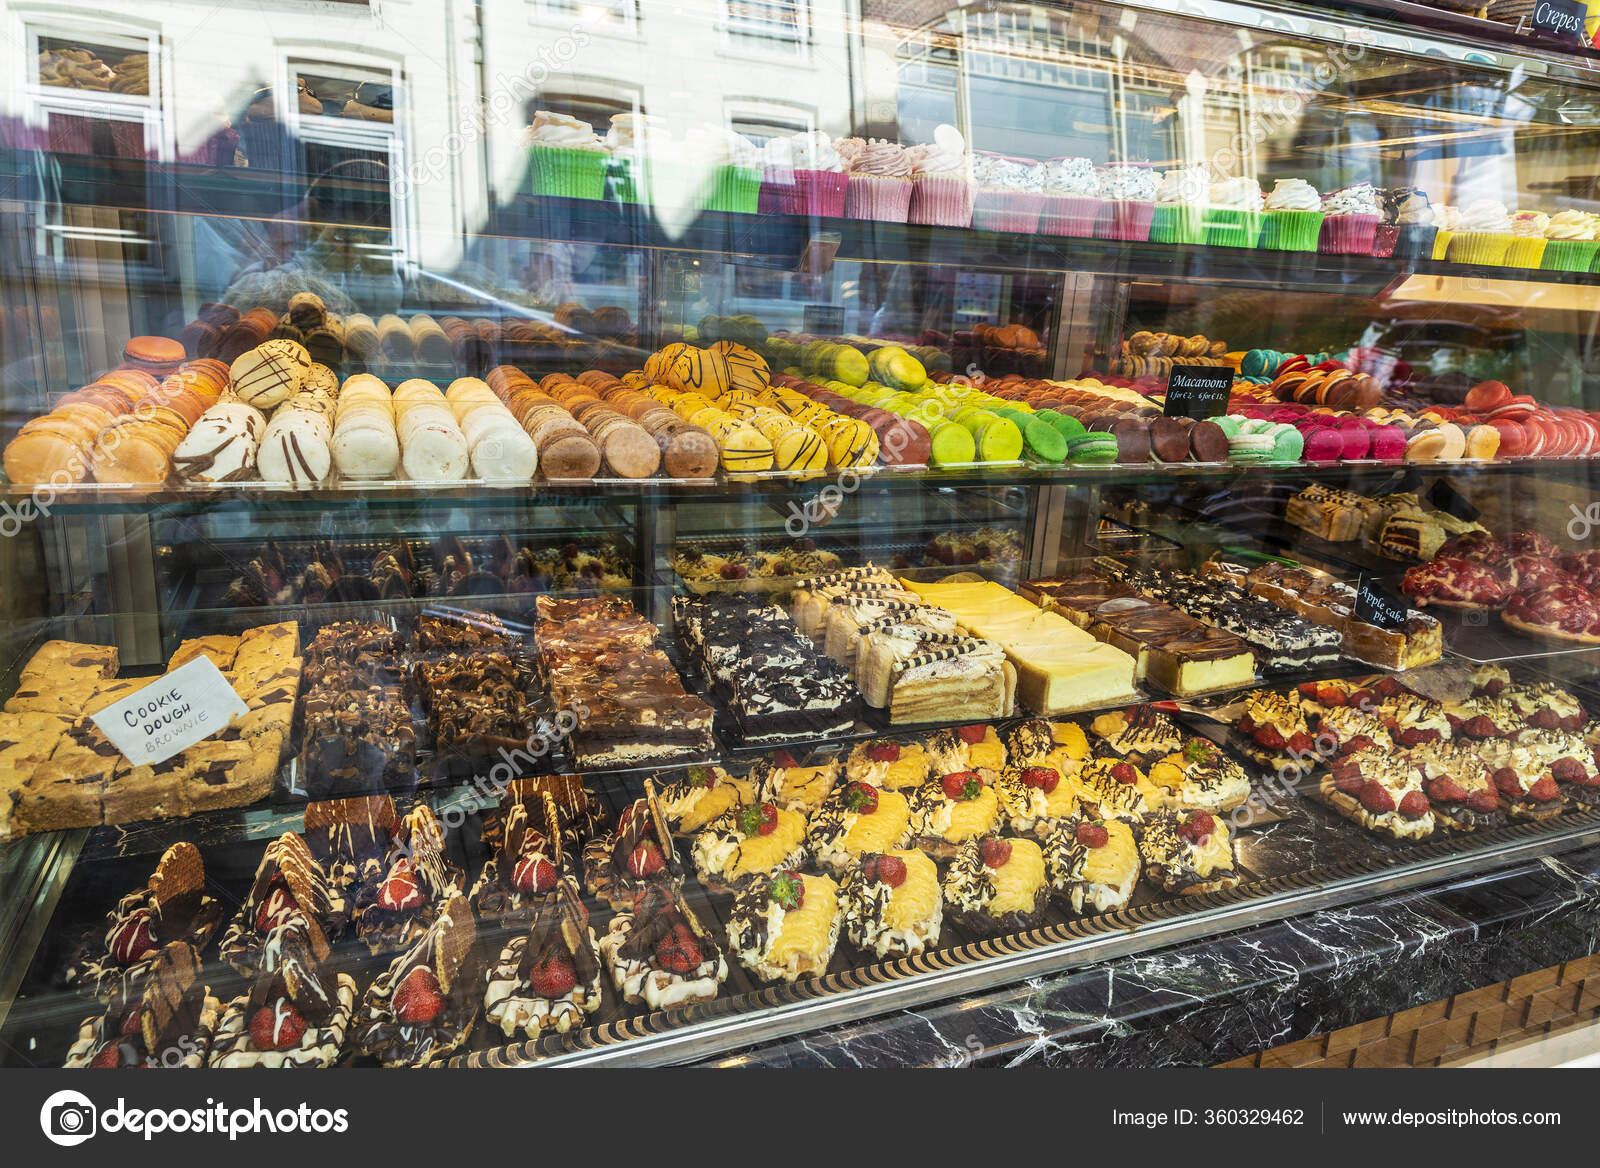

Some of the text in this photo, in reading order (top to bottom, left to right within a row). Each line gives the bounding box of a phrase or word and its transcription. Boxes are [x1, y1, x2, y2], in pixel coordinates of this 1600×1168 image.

[1536, 2, 1581, 34] Crepes
[1172, 375, 1228, 388] Macaroons
[1358, 586, 1405, 623] Apple cake
[1372, 610, 1387, 623] pie
[123, 688, 183, 728] COOKIE
[143, 703, 191, 736] DOUGH
[145, 710, 209, 753] BROWNIE
